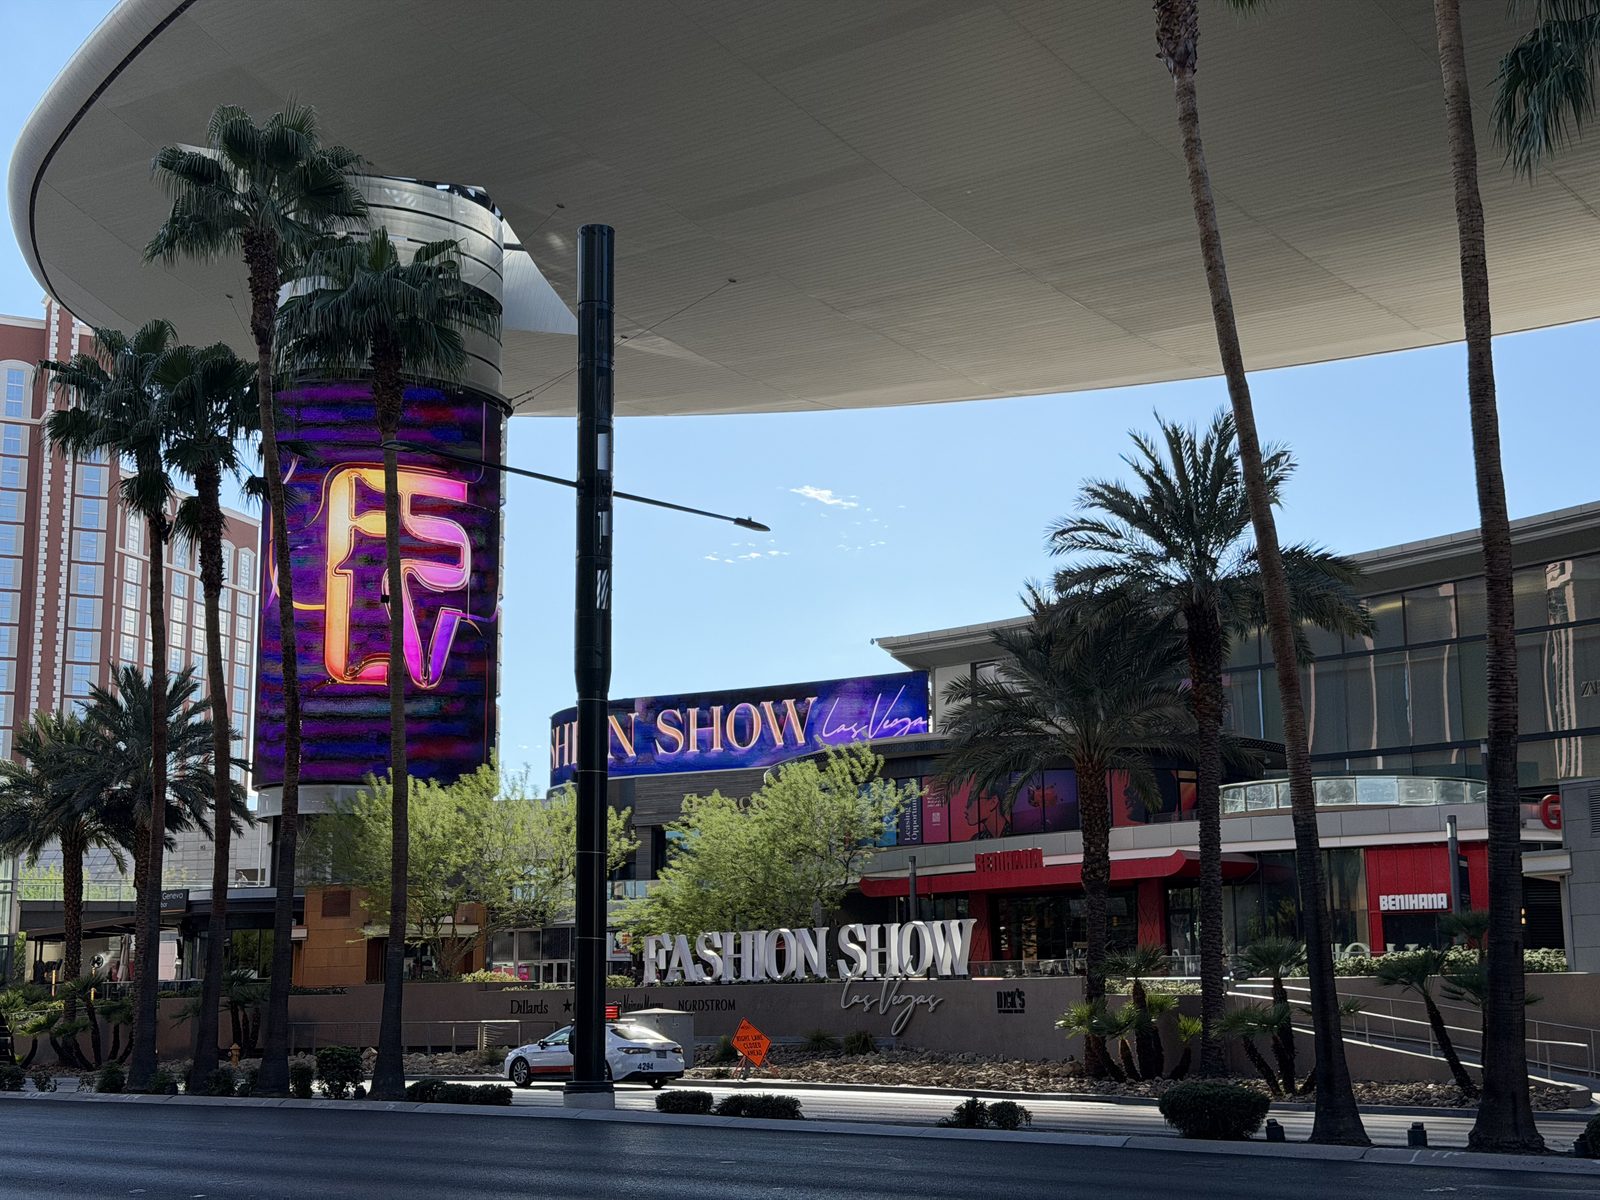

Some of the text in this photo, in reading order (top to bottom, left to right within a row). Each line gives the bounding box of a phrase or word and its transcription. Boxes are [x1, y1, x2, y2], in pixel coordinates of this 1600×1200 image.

[655, 696, 818, 756] SHOW
[822, 697, 868, 738] Las
[904, 806, 912, 841] Leasing
[1379, 893, 1448, 911] BENIHANA
[643, 926, 830, 986] FASHION
[837, 918, 978, 980] SHOW
[678, 999, 736, 1012] NORDSTROM
[840, 956, 944, 1036] Las Vegas
[637, 1062, 654, 1070] 4294
